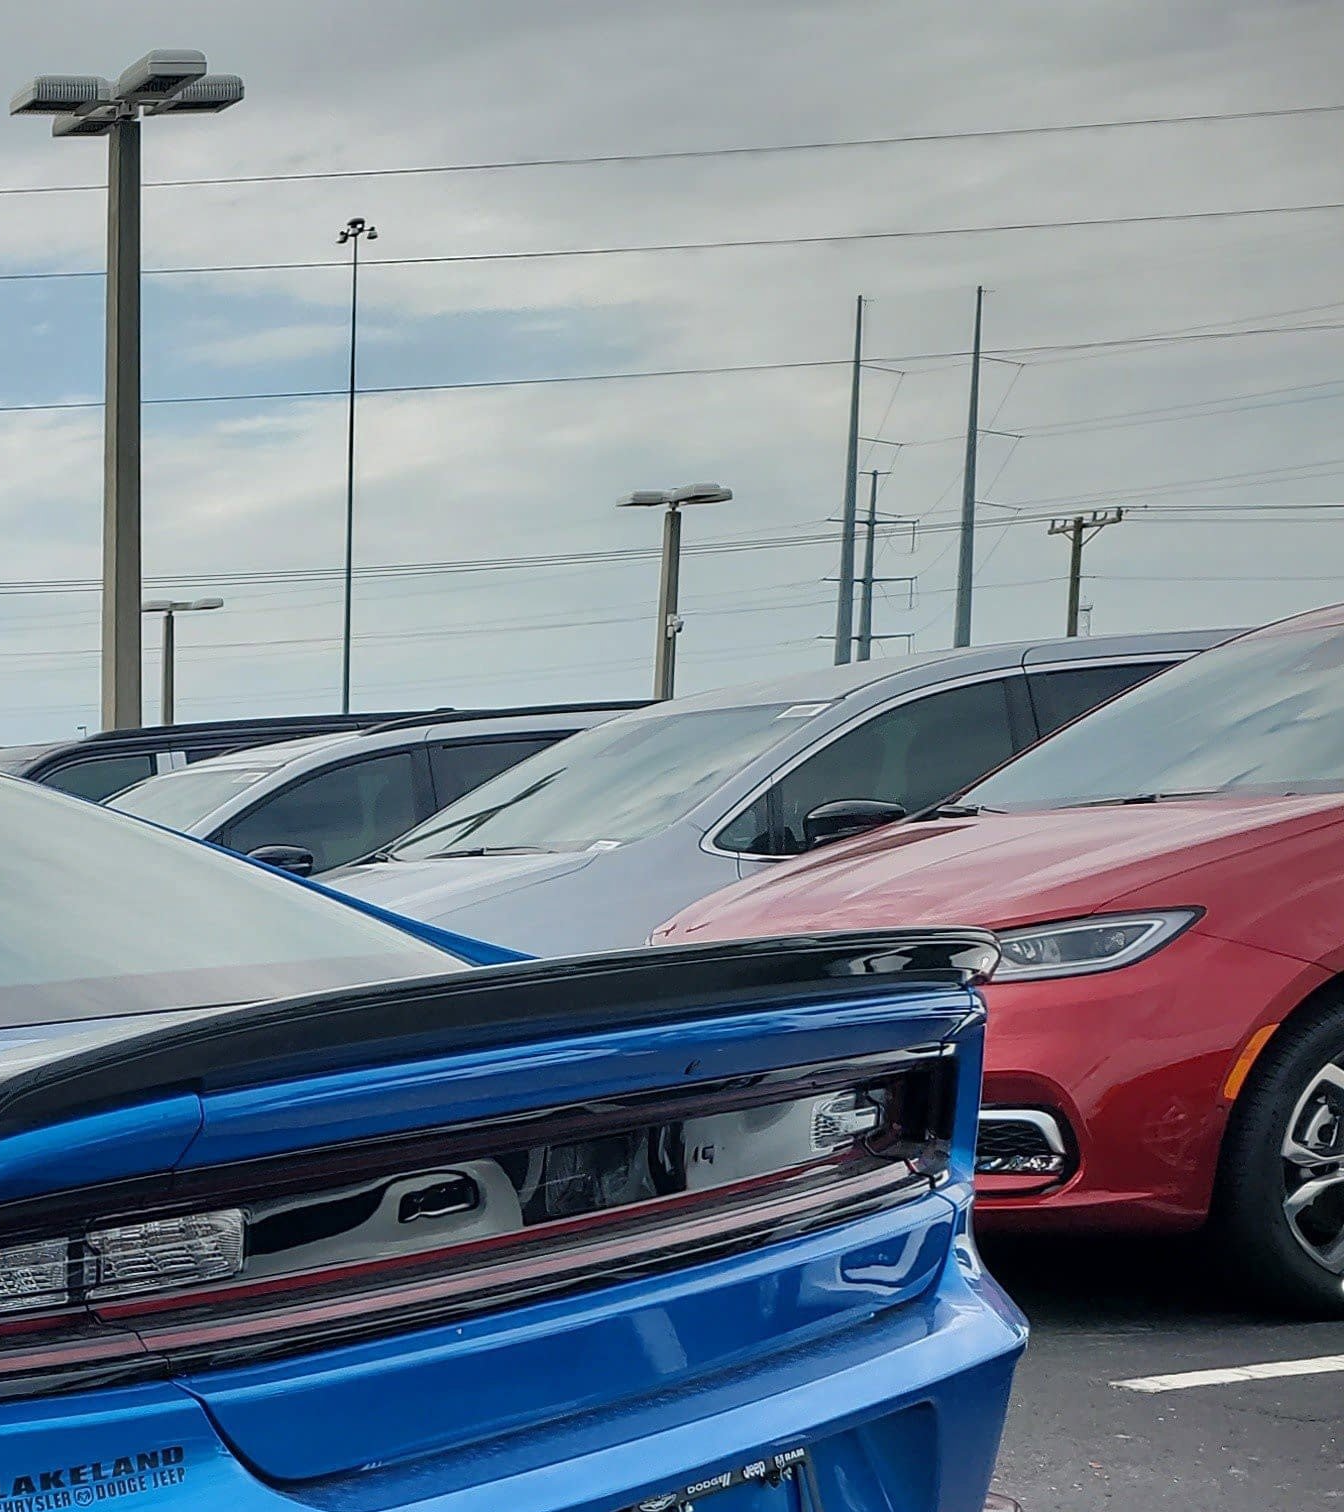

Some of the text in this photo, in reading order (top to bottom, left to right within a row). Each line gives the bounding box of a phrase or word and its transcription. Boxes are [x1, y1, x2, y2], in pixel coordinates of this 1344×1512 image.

[743, 1460, 766, 1479] Jeep
[784, 1448, 806, 1461] RAM
[97, 1478, 147, 1501] DODGE
[152, 1466, 186, 1490] JEEP
